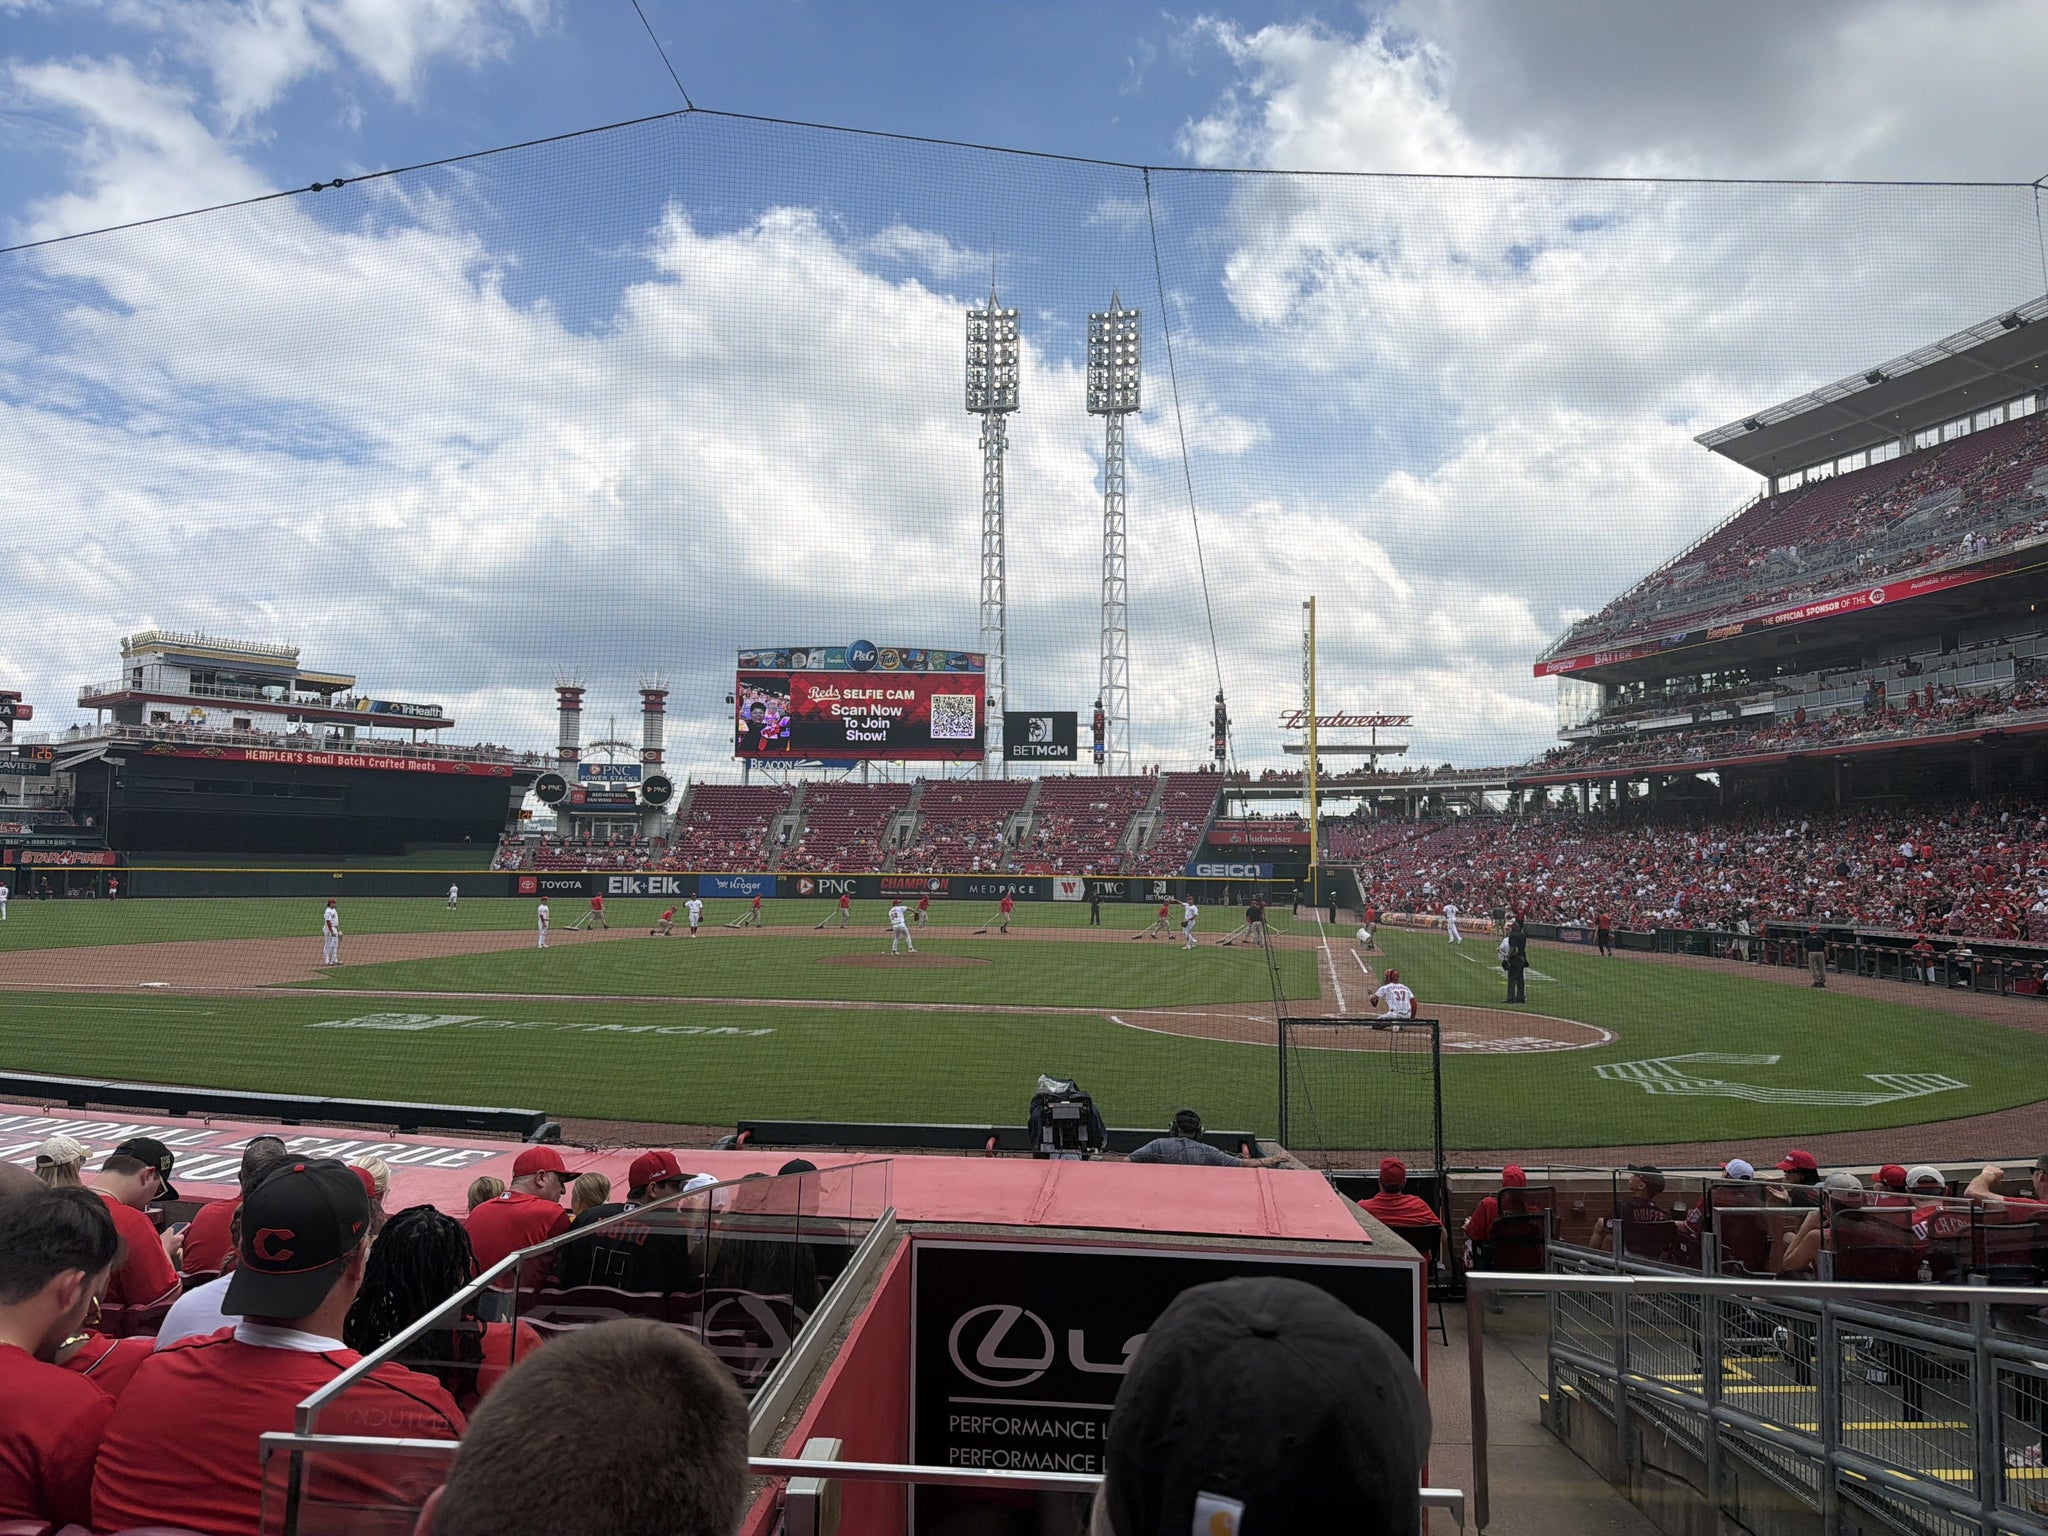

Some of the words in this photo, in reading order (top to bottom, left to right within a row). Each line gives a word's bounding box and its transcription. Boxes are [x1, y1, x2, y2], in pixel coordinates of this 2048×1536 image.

[1762, 617, 1775, 627] THE
[1774, 611, 1805, 624] OFFICIAL
[1806, 601, 1840, 616] SPONSOR
[1840, 600, 1851, 609] OF
[1852, 594, 1867, 605] THE
[1706, 623, 1744, 641] Energizer
[852, 649, 876, 662] P&G
[880, 652, 898, 665] Tide
[1594, 650, 1633, 665] BATTER
[1545, 658, 1576, 673] Energizer
[807, 684, 841, 703] Reds
[843, 689, 884, 700] SELFIE
[886, 689, 915, 700] CAM
[400, 703, 443, 717] TriHealth
[831, 703, 868, 716] Scan
[870, 704, 902, 716] Now
[843, 717, 859, 729] To
[861, 717, 890, 729] Join
[846, 729, 887, 742] Show!
[1013, 745, 1069, 756] BETMGM
[245, 749, 303, 763] HEMPLER'S
[306, 754, 334, 765] Small
[337, 756, 366, 767] Batch
[369, 758, 405, 769] Crafted
[408, 760, 436, 771] Meats
[749, 758, 794, 770] BEACON
[602, 765, 632, 775] PNC
[1244, 834, 1293, 843] Budweiser
[1195, 863, 1261, 877] GEICO
[540, 880, 582, 889] TOYOTA
[729, 876, 762, 895] Kroger
[817, 879, 857, 894] PNC
[969, 883, 1035, 894] MEDPACE
[1061, 882, 1076, 894] W
[1092, 881, 1125, 895] TWC
[1394, 990, 1406, 1002] 37
[460, 1020, 778, 1036] BETMGM
[253, 1228, 296, 1261] C
[949, 1414, 1096, 1440] PERFORMANCE
[949, 1447, 1096, 1473] PERFORMANCE
